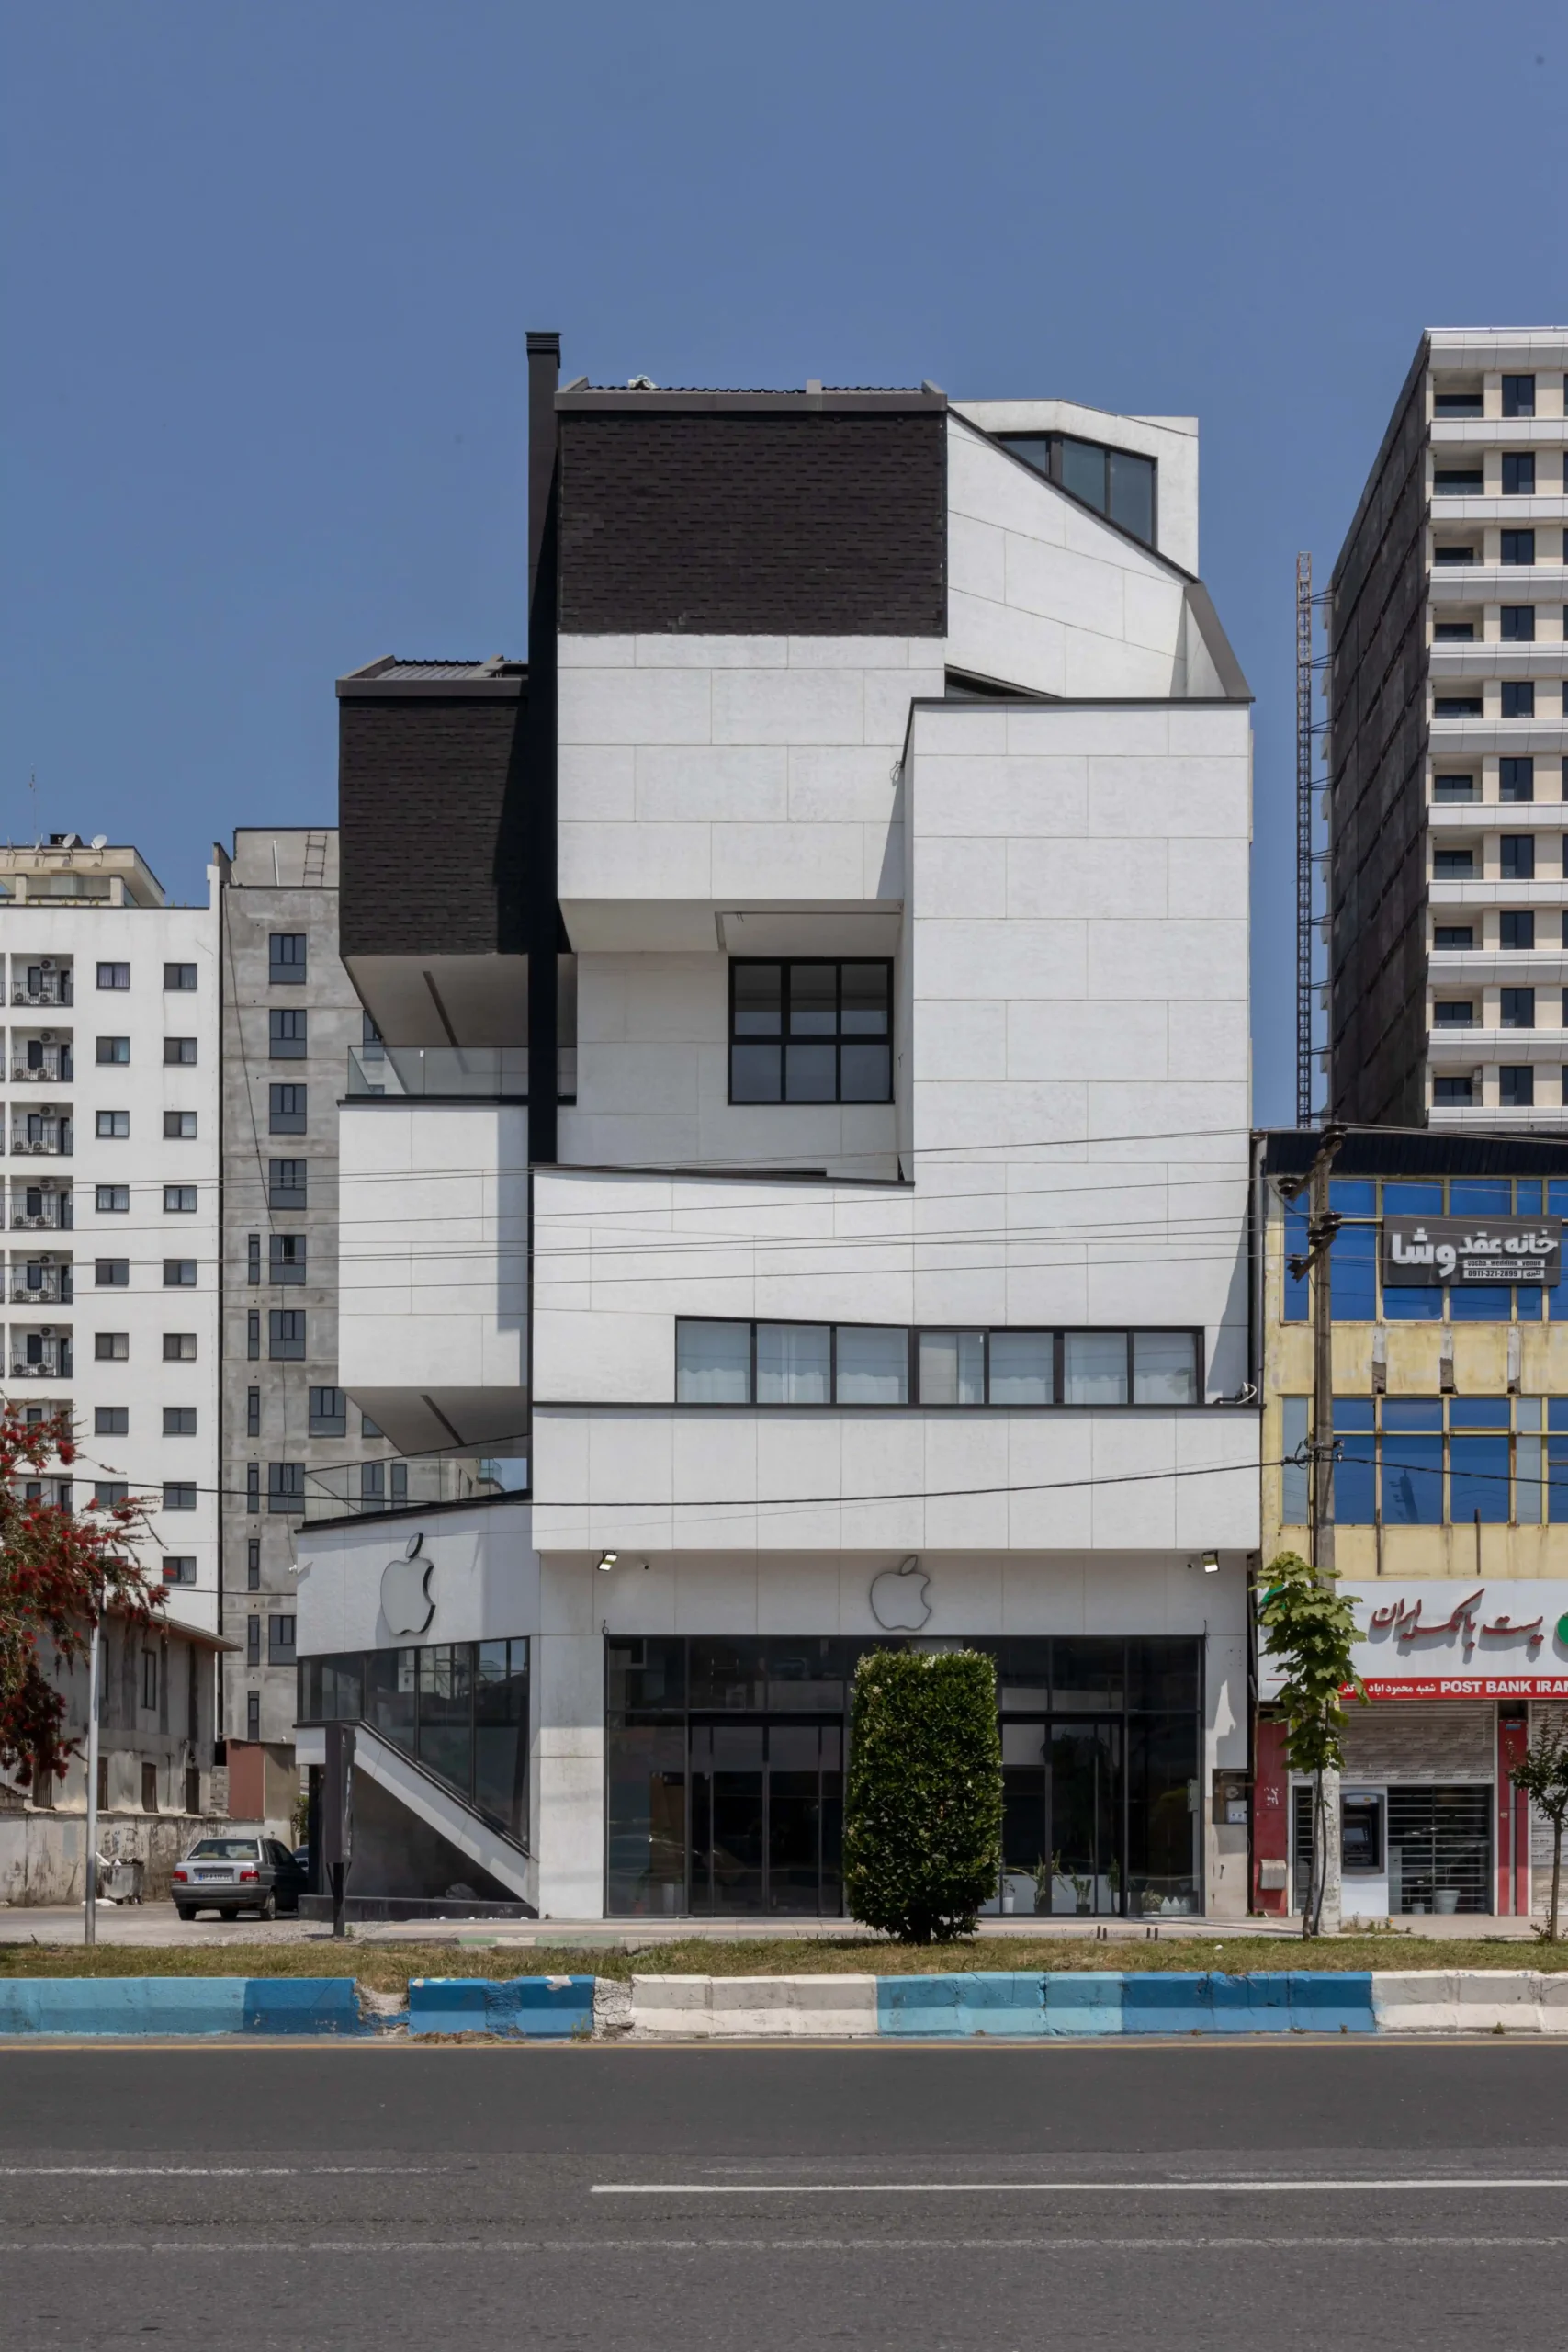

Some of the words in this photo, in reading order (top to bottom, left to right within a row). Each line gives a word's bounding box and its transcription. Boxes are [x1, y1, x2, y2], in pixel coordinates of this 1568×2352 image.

[1459, 1231, 1501, 1254] عقد
[1504, 1229, 1559, 1254] خانه
[1371, 1598, 1422, 1640] ایران
[1413, 1588, 1485, 1649] بانک
[1482, 1615, 1544, 1646] پست
[1416, 1683, 1436, 1695] شعبه
[1440, 1680, 1483, 1693] POST
[1485, 1680, 1532, 1693] BANK
